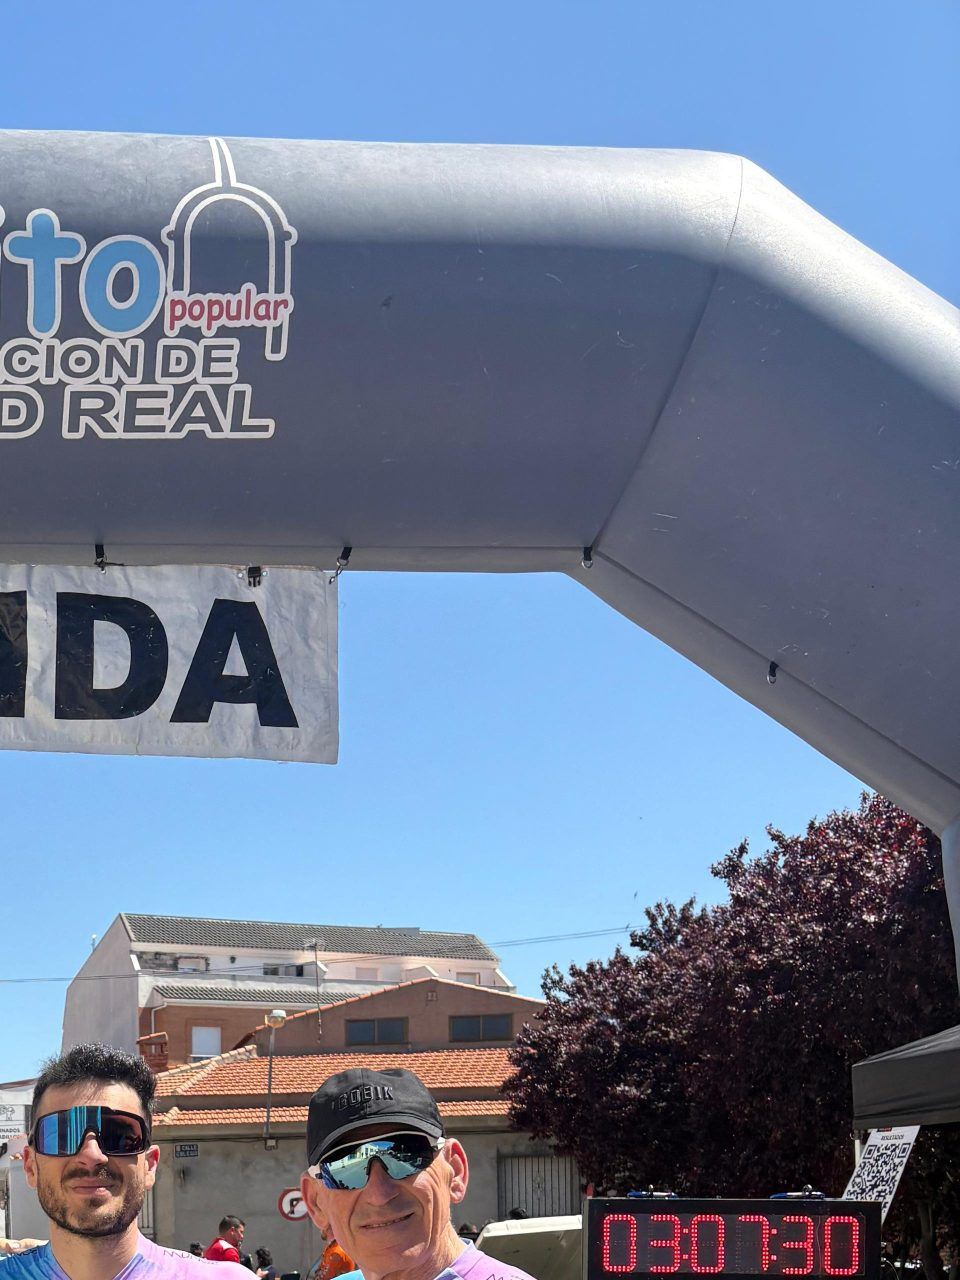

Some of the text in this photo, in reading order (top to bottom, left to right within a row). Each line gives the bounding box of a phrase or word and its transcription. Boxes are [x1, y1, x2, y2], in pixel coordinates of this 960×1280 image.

[166, 289, 291, 334] popular
[155, 340, 239, 383] DE
[62, 384, 275, 439] REAL
[603, 1214, 859, 1275] 03:07:30
